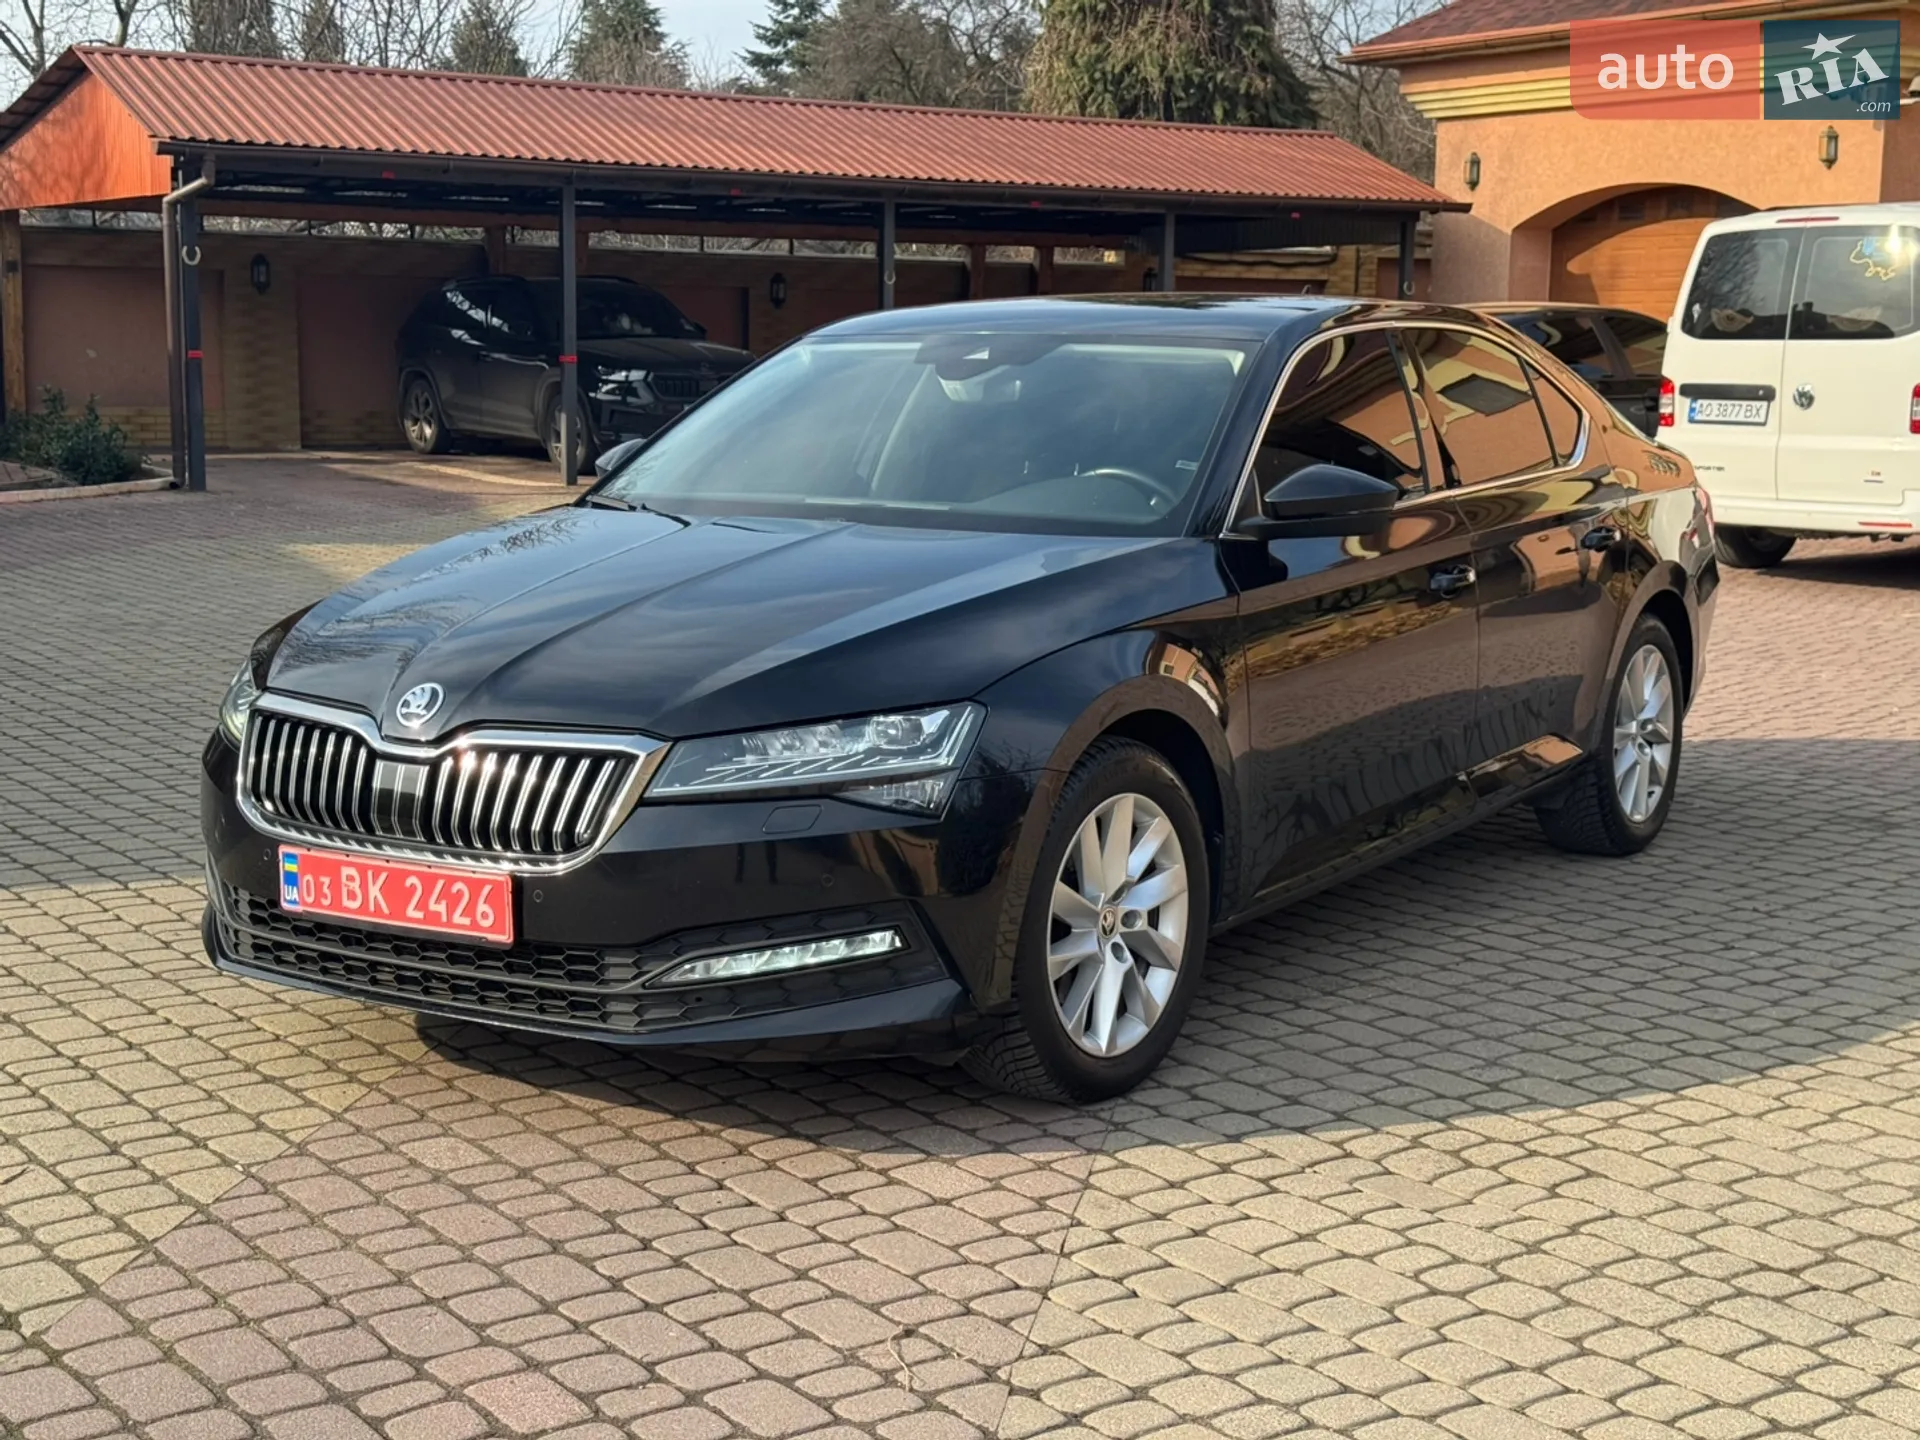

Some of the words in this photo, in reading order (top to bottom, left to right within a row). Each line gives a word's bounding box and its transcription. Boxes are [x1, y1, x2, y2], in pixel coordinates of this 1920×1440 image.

[1715, 401, 1742, 418] 3877
[1744, 402, 1762, 419] BX
[284, 885, 300, 902] UA
[302, 874, 332, 906] 03
[340, 866, 391, 915] BK
[404, 875, 496, 928] 2426
